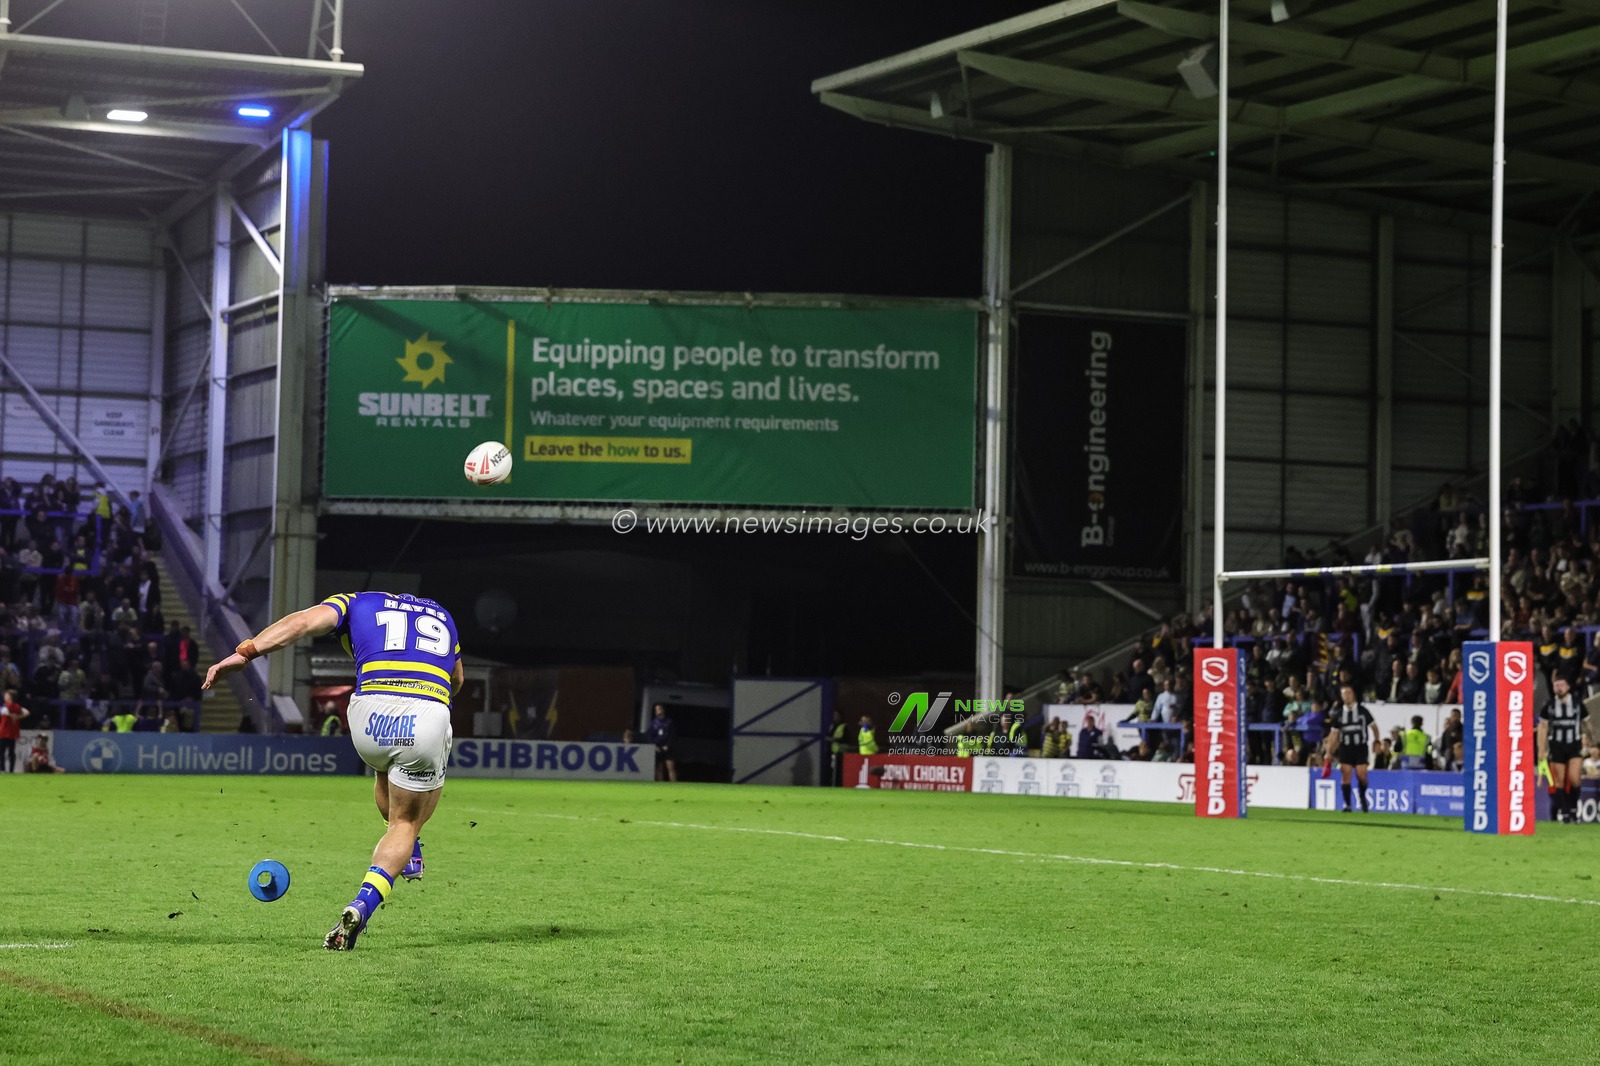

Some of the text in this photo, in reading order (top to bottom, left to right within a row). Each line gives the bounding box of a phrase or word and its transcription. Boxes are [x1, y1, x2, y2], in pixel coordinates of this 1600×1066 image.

[532, 337, 940, 371] Equipping people to transform
[531, 372, 859, 403] places, spaces and lives.
[358, 392, 491, 418] SUNBELT
[376, 417, 471, 428] RENTALS
[530, 410, 839, 432] Whatever your equipment requirements
[530, 441, 686, 459] Leave the how to us.
[375, 610, 451, 657] 19
[365, 712, 417, 742] SQUARE
[394, 738, 415, 747] OFFICES
[1207, 691, 1226, 815] BETFRED
[138, 745, 252, 771] Halliwell
[260, 747, 337, 773] Jones
[880, 764, 910, 780] JOHN
[914, 765, 966, 783] CHORLEY
[1472, 690, 1489, 831] BETFRED
[1508, 690, 1526, 832] BETFRED
